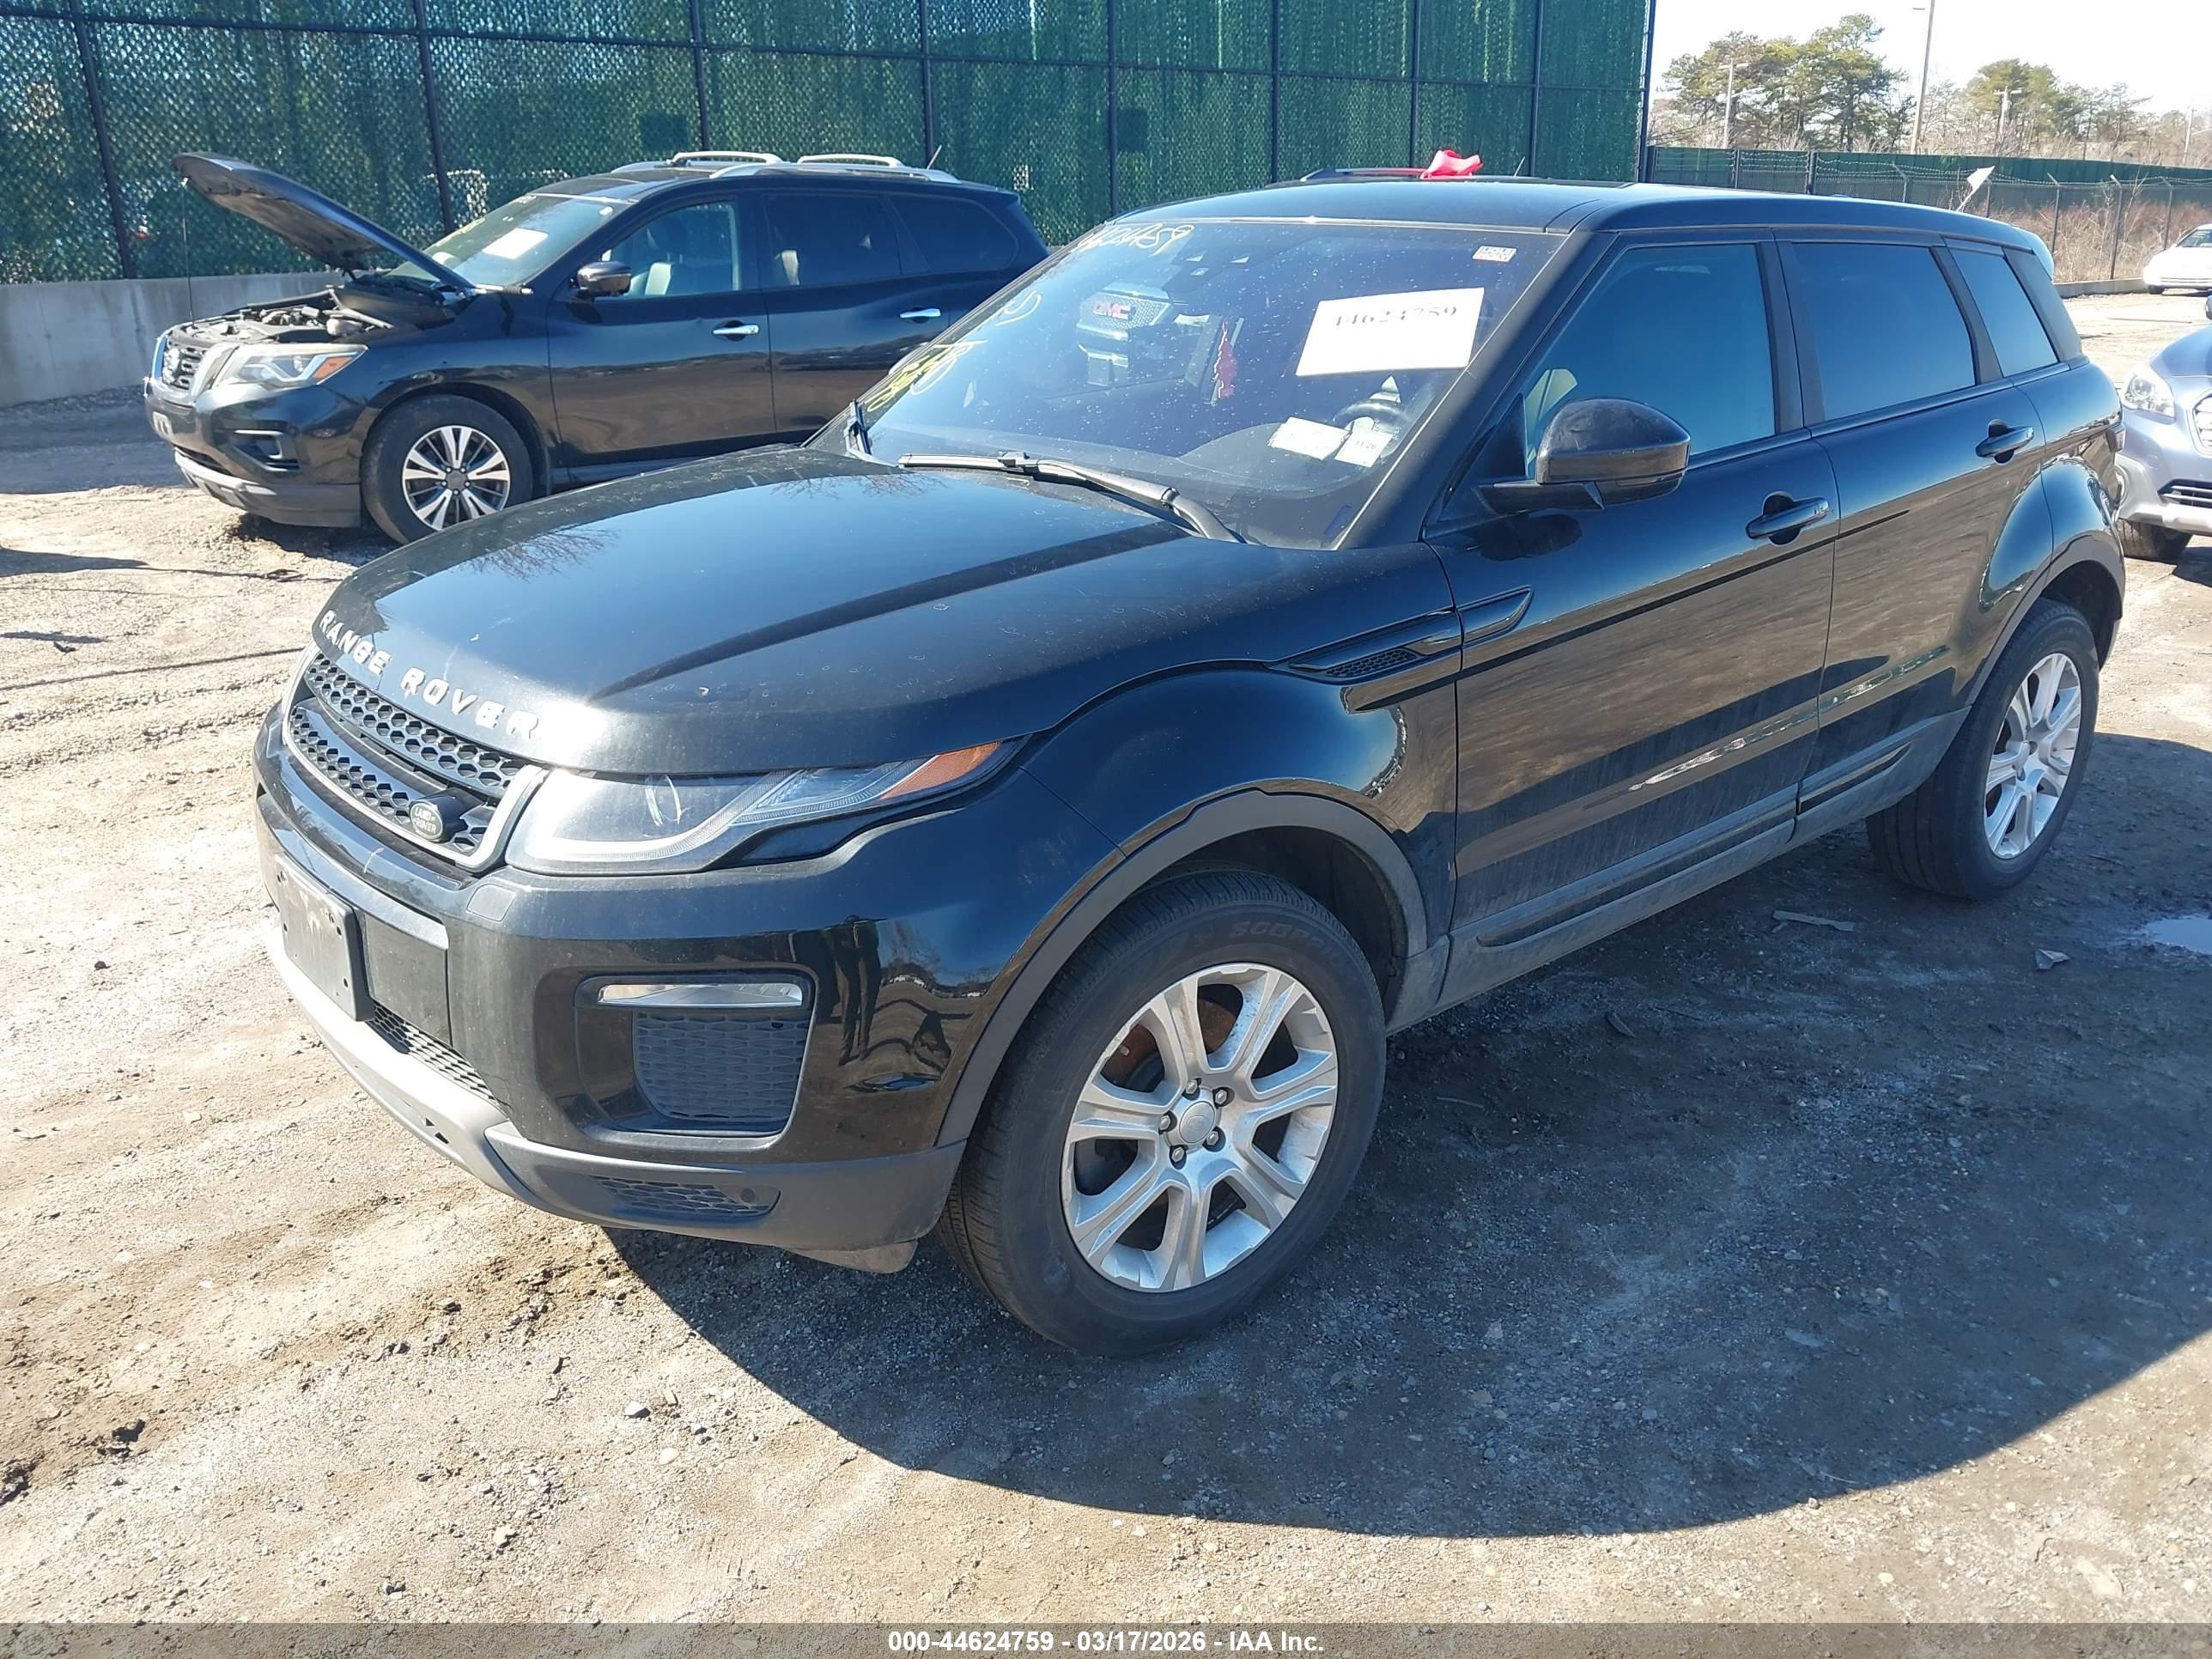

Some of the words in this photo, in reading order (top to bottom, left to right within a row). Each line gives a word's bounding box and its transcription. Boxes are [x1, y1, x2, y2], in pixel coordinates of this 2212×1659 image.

[1092, 301, 1131, 320] GMC
[319, 610, 392, 676] RANGE
[400, 667, 539, 740] ROVER
[415, 807, 432, 821] LAND
[416, 818, 436, 834] ROVER
